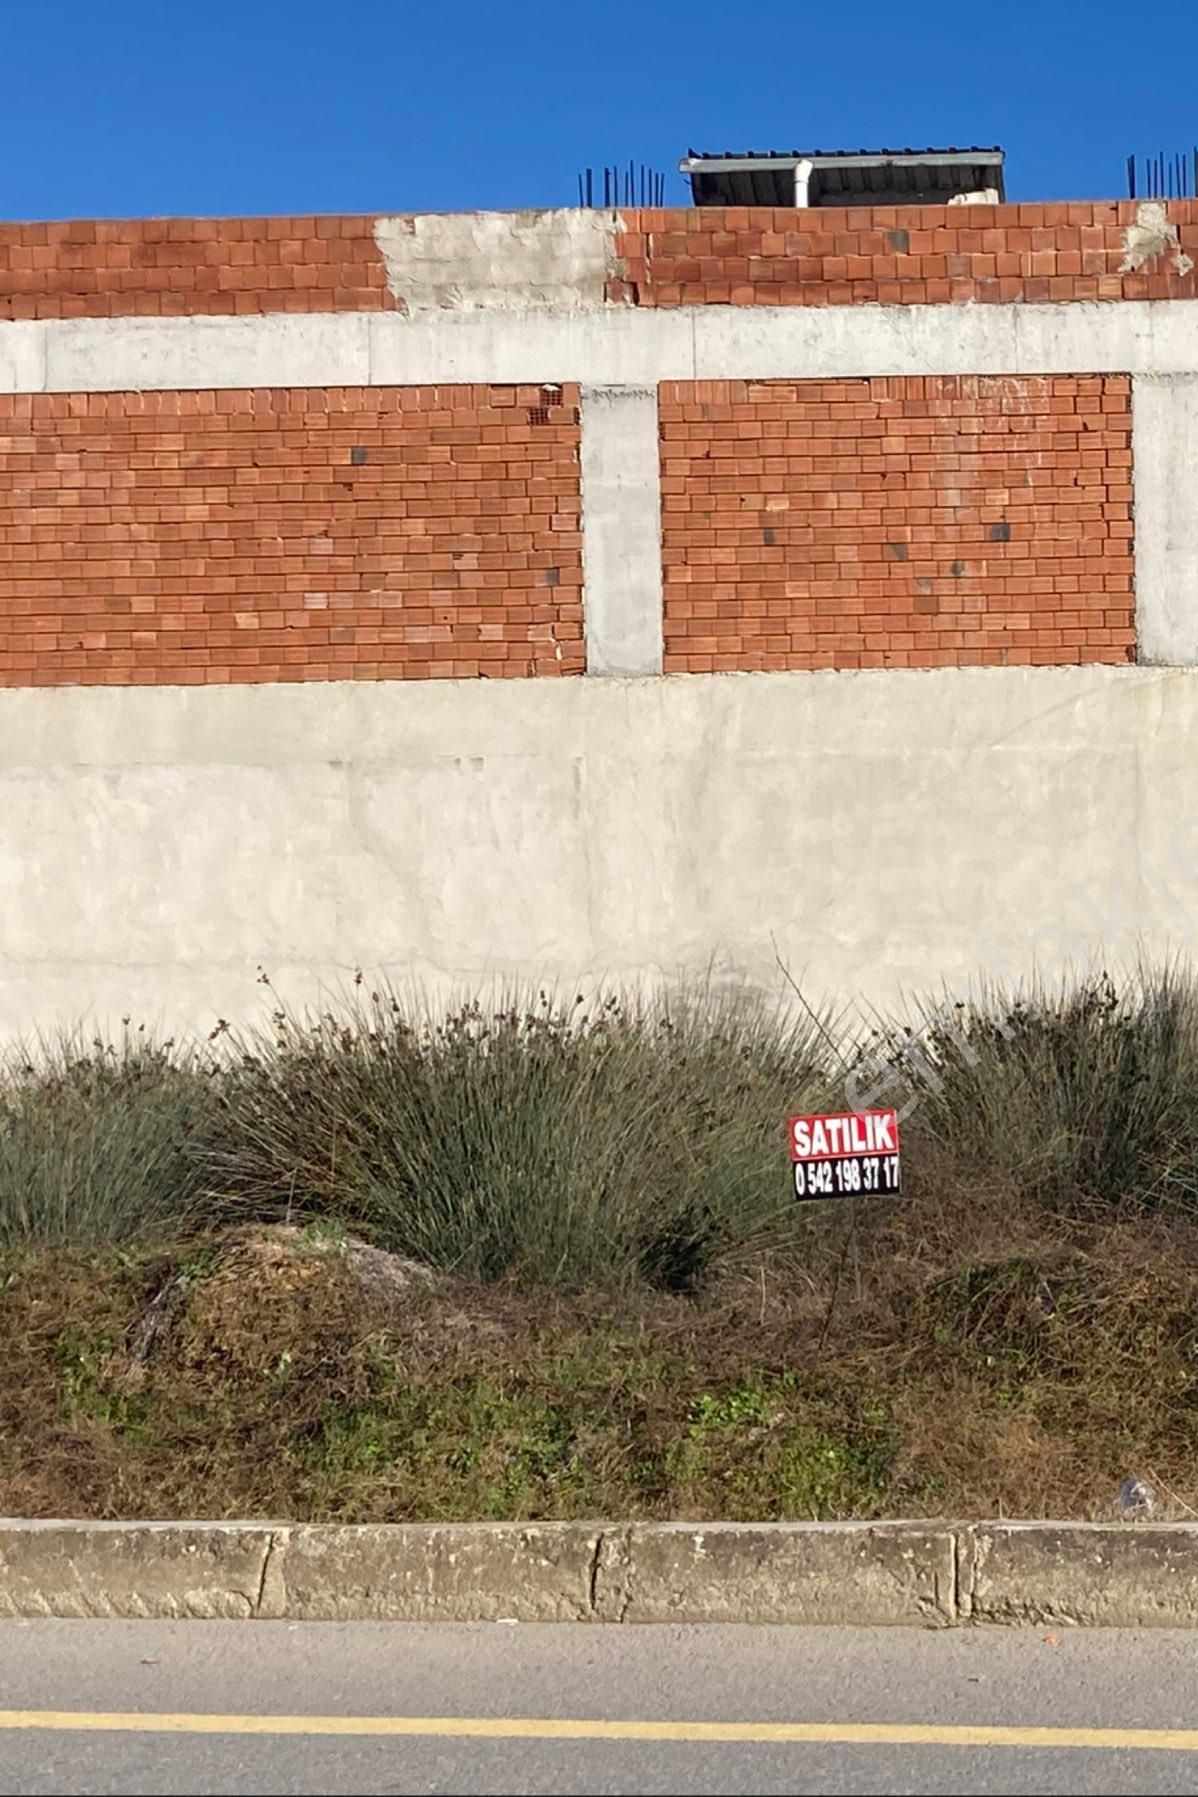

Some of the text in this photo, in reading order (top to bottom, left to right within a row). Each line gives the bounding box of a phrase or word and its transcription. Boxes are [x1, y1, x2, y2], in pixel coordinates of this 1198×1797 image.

[794, 1113, 895, 1157] SATILIK
[795, 1156, 899, 1195] 0 542 198 37 17
